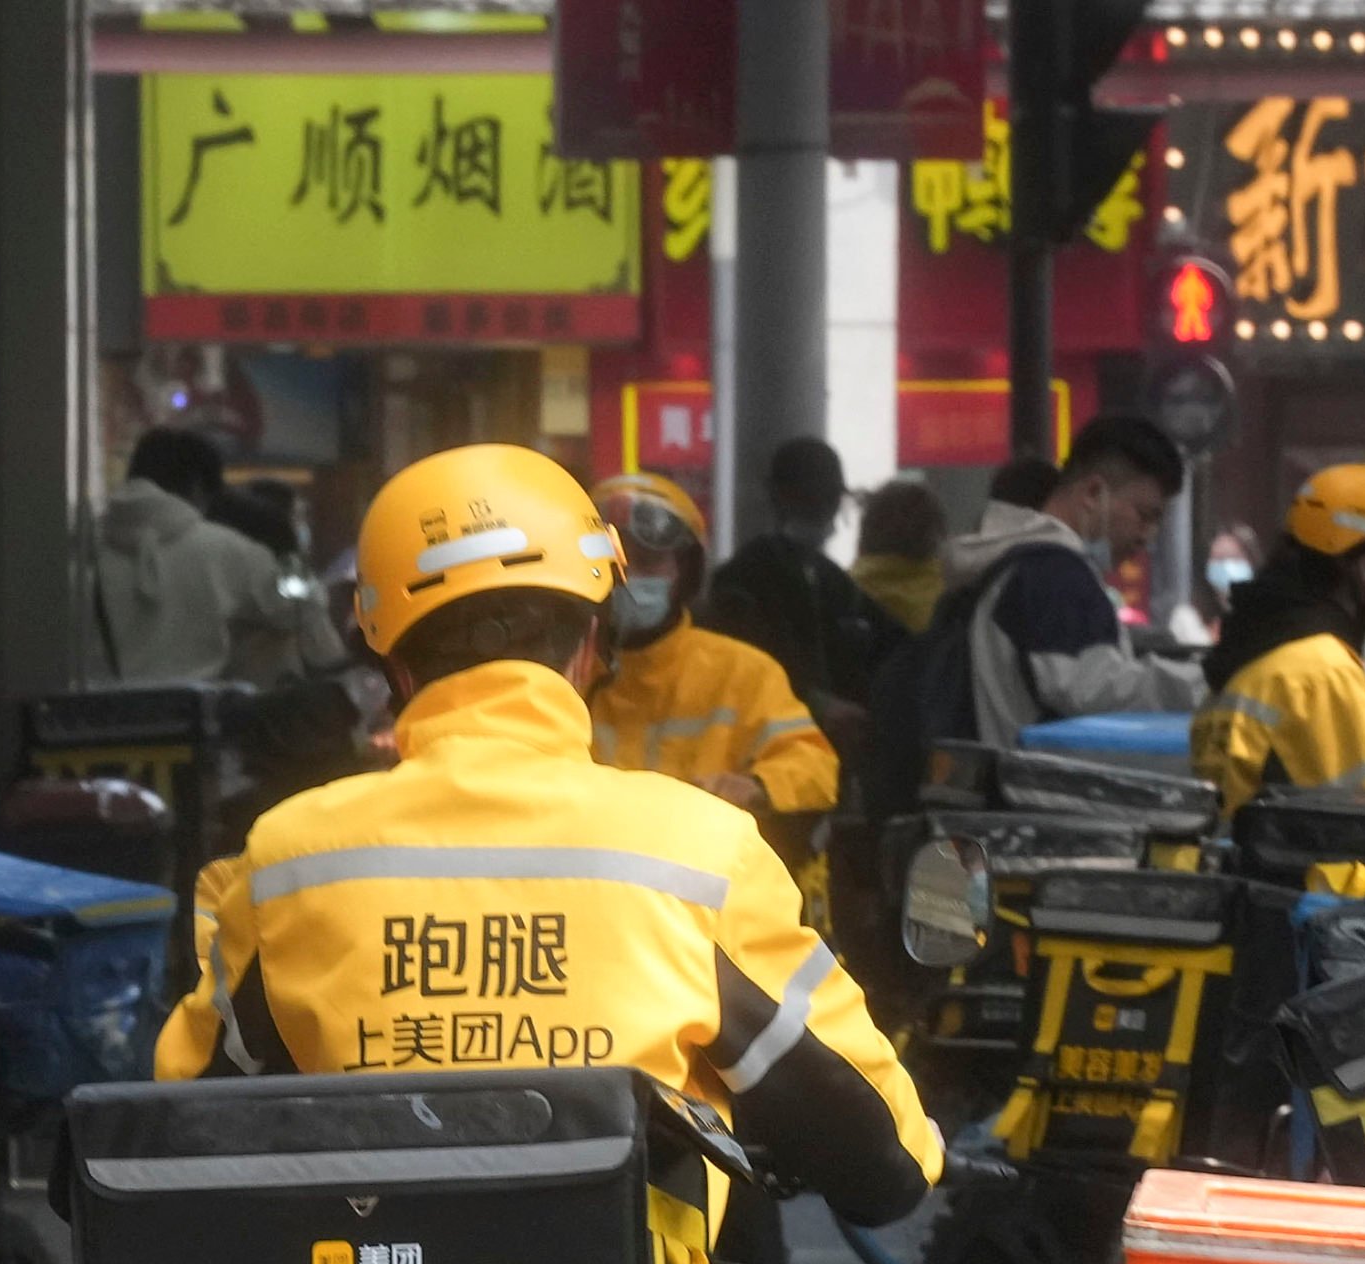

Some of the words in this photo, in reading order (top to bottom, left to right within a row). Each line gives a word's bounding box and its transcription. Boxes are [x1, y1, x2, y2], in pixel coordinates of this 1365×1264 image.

[380, 912, 569, 997] 跑腿
[343, 1010, 615, 1072] 上美团App
